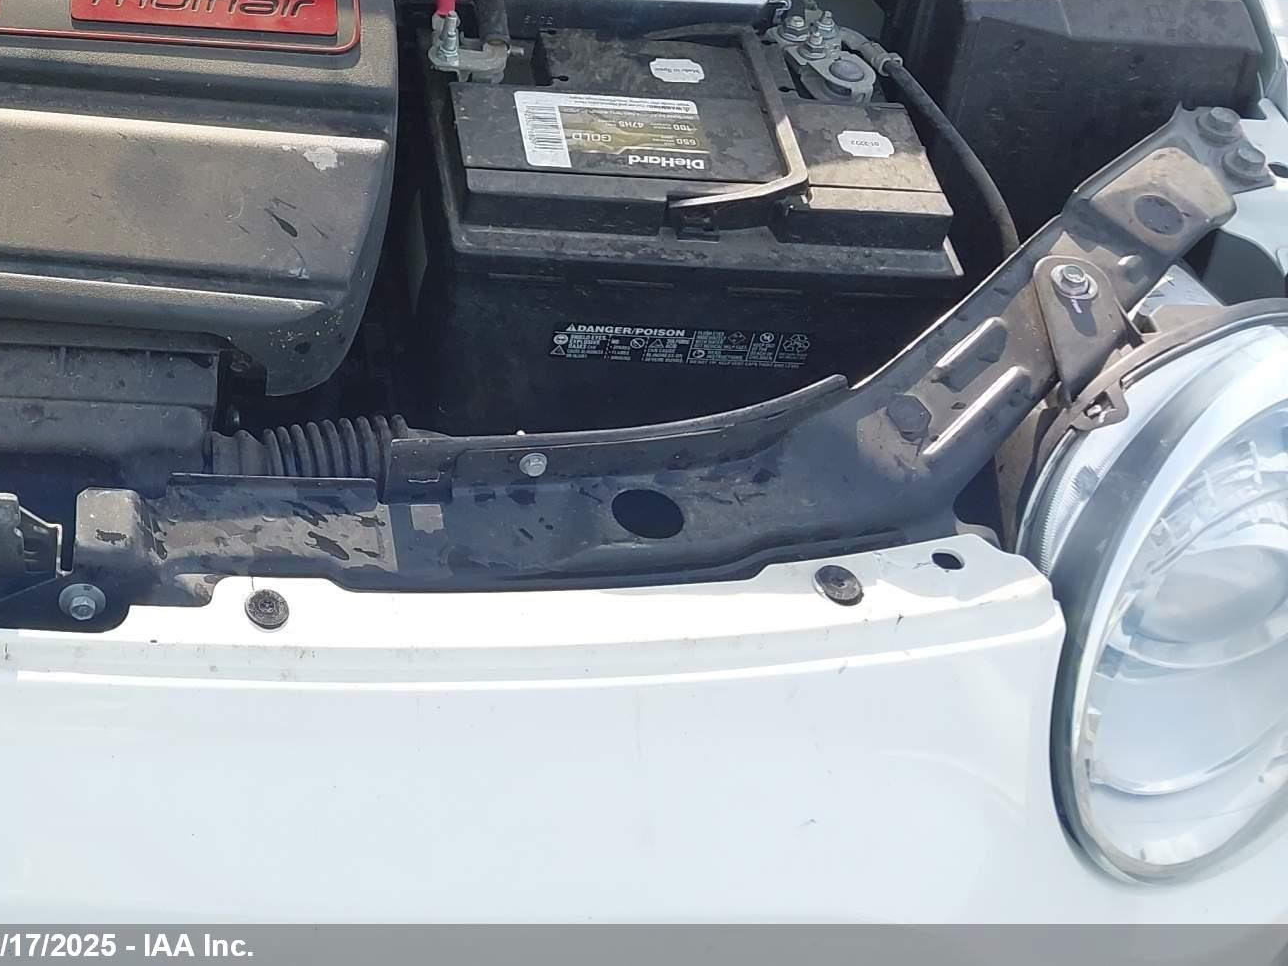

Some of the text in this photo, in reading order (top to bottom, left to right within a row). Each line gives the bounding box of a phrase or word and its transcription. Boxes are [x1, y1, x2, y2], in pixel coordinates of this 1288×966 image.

[572, 132, 612, 142] GOLD
[676, 137, 698, 146] 650
[628, 154, 705, 170] DieHard
[576, 325, 685, 337] DANGER/POISON
